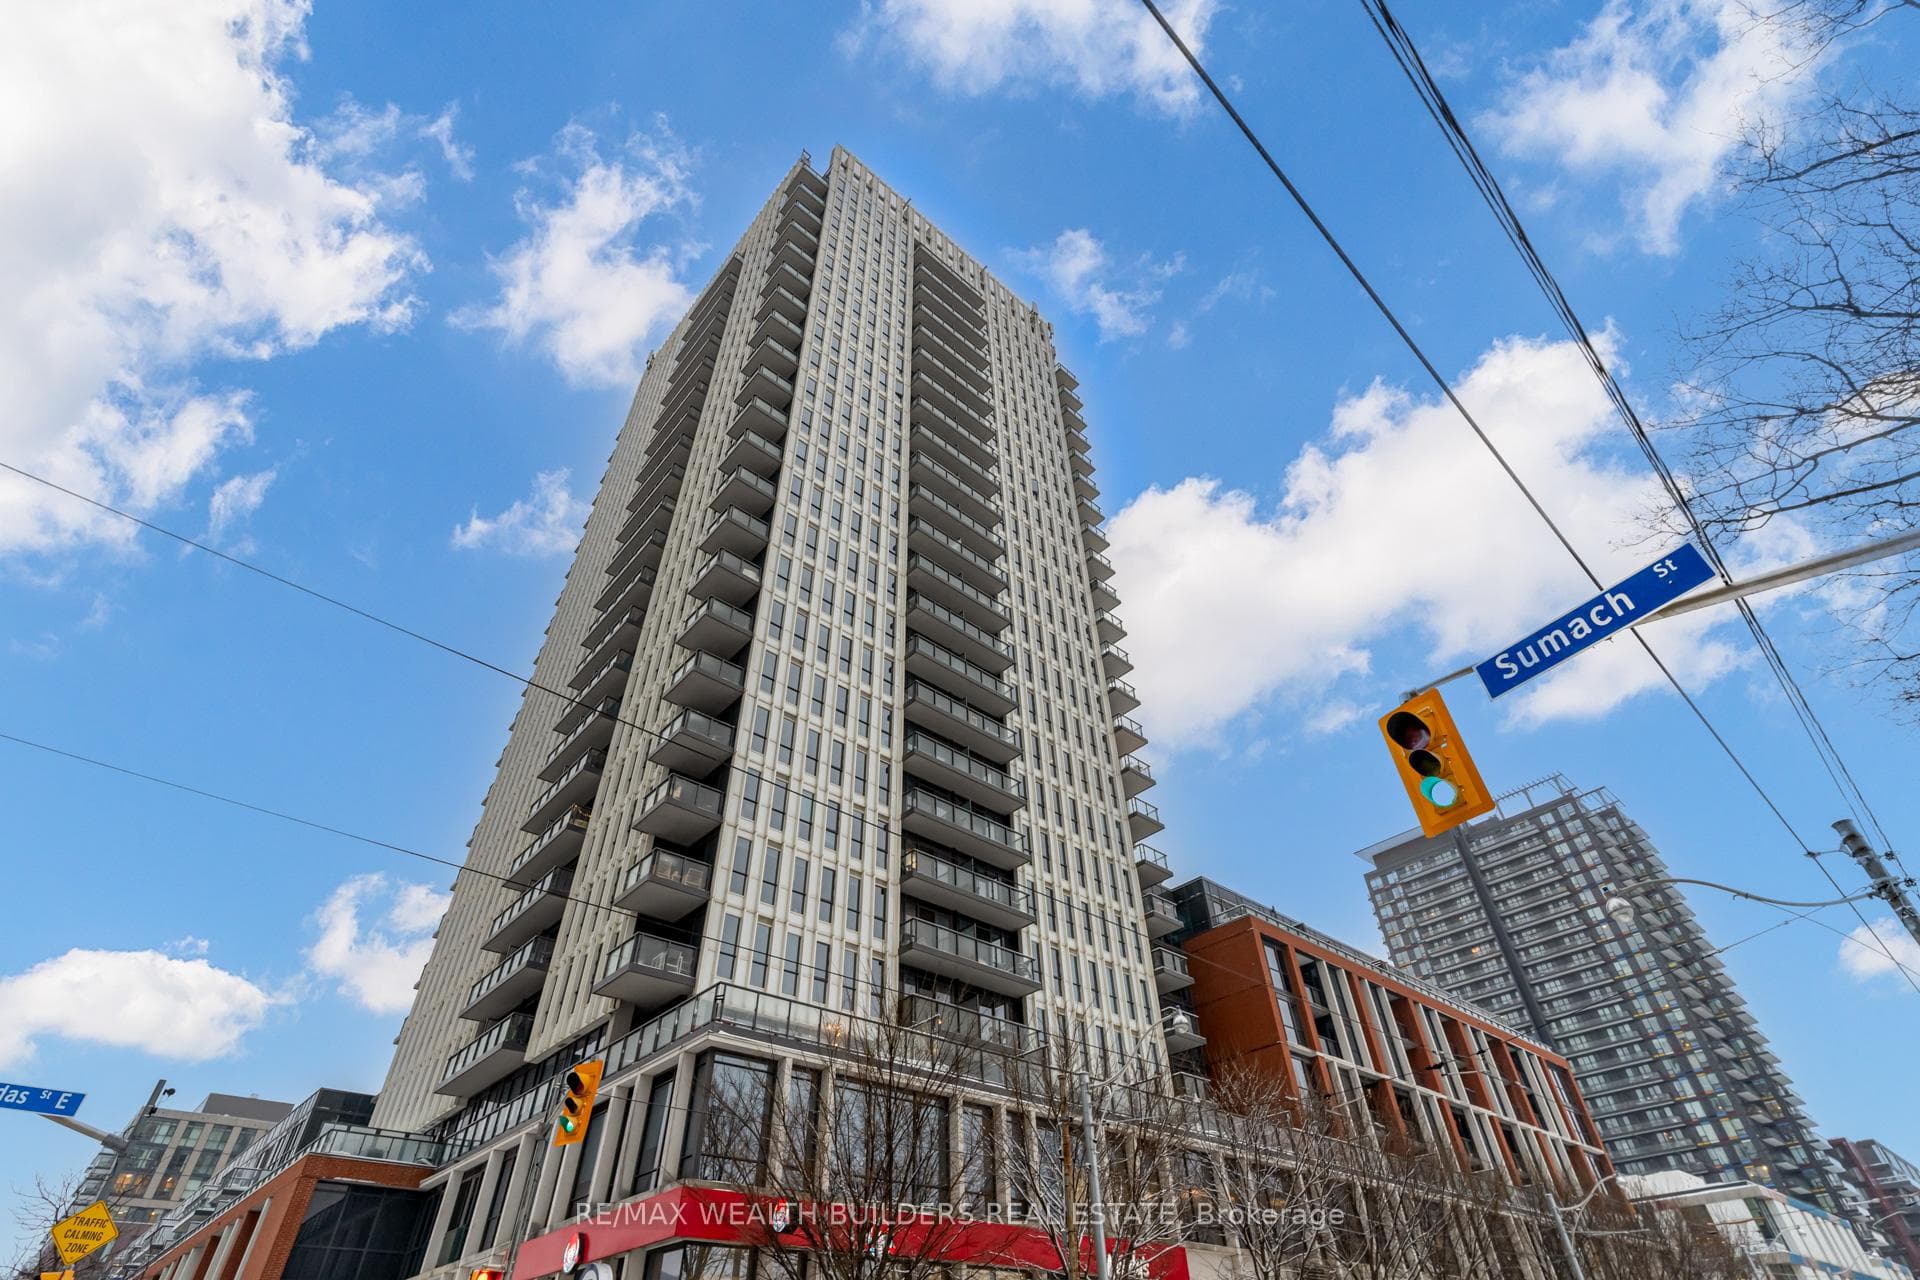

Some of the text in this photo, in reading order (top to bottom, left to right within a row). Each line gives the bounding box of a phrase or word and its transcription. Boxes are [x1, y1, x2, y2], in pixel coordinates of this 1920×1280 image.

[1495, 560, 1678, 680] Sumach St
[40, 1090, 53, 1100] St
[54, 1093, 73, 1109] E
[73, 1216, 109, 1229] TRAFFIC
[63, 1228, 104, 1242] CALMING
[64, 1242, 90, 1254] ZONE
